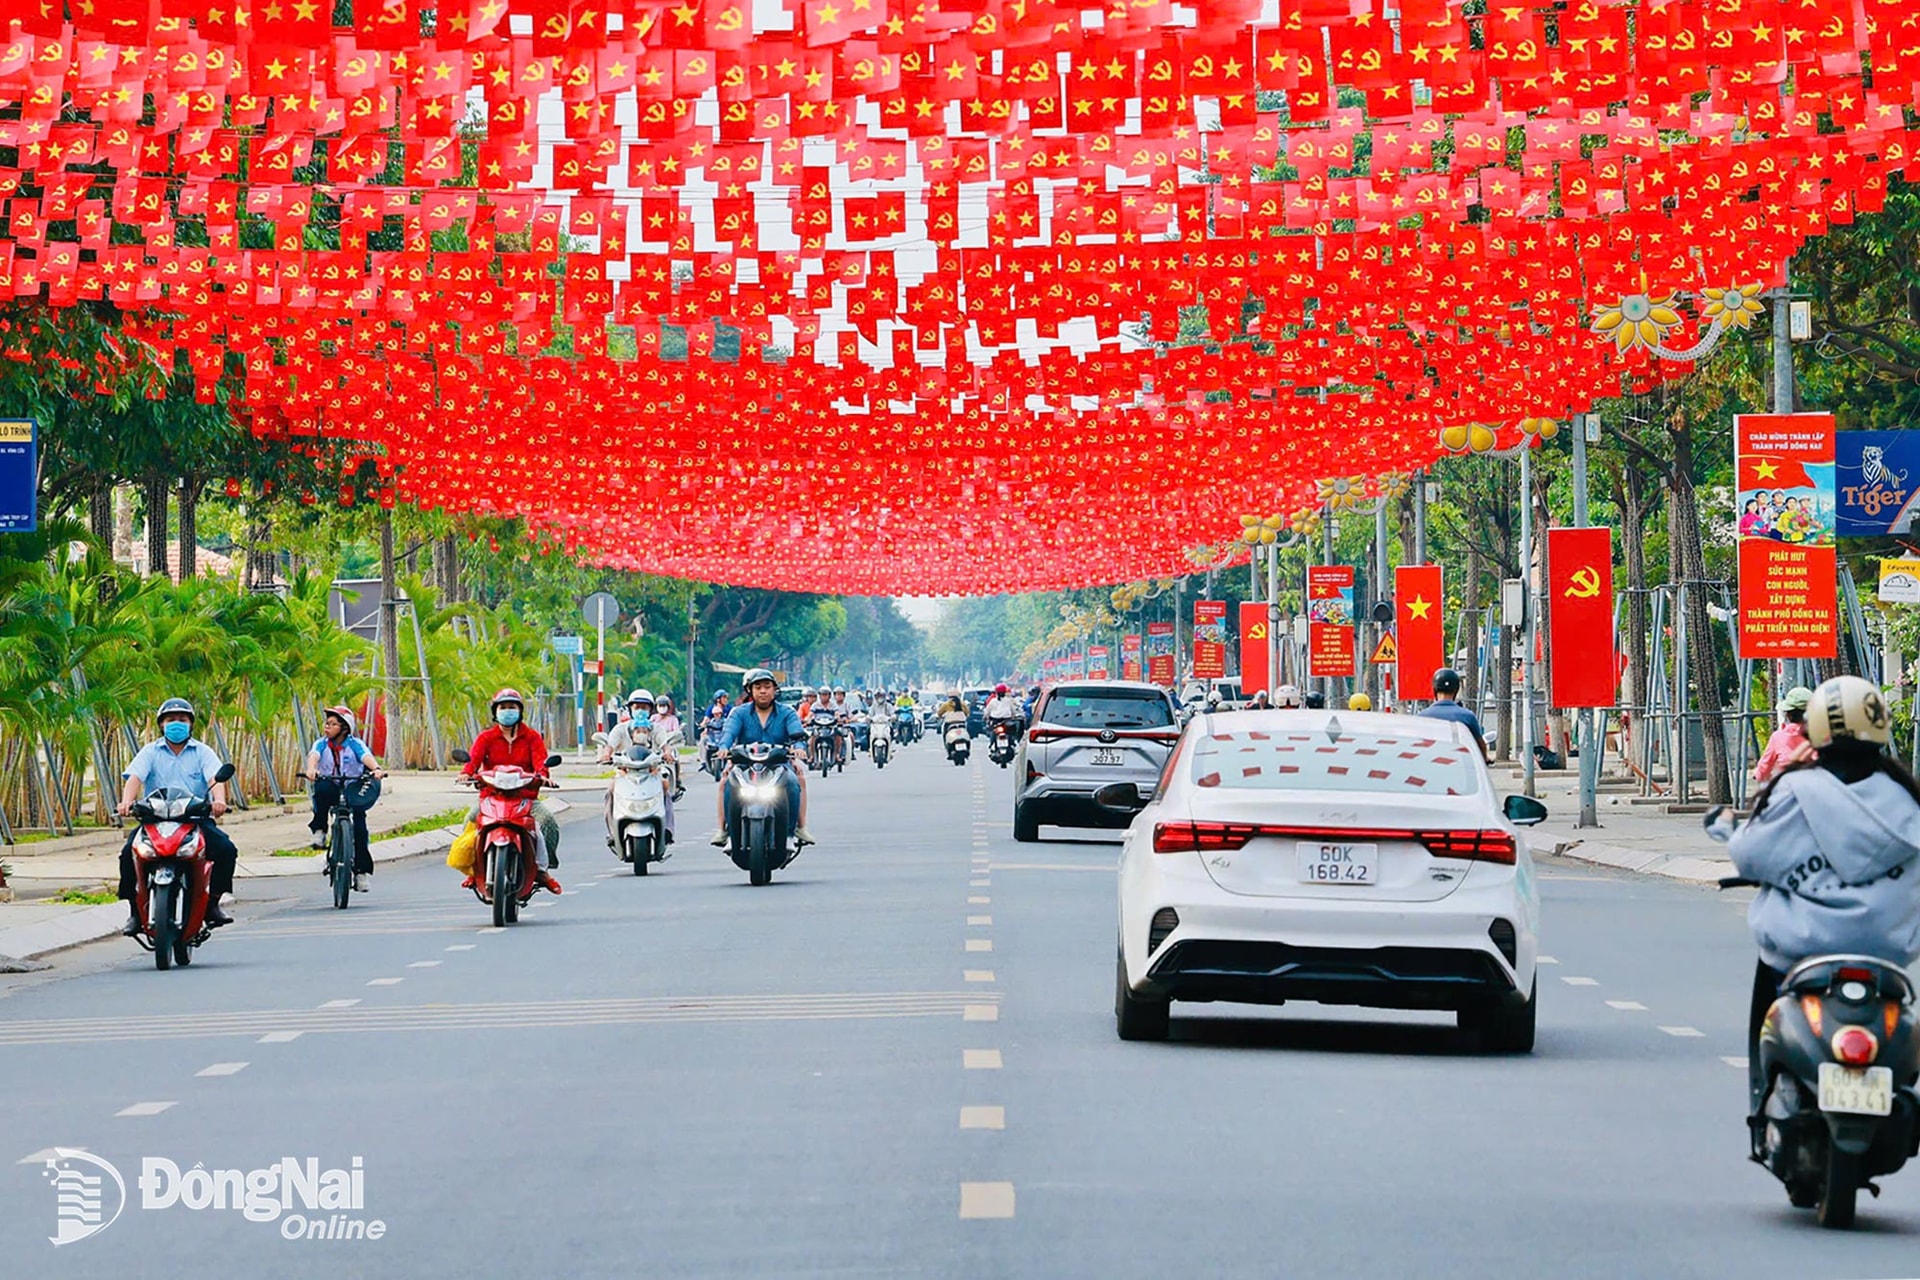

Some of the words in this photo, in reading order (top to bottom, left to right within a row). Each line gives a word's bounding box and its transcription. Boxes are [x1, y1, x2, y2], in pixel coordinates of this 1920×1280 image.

[1789, 432, 1811, 440] THÀNH
[1752, 441, 1773, 450] THÀNH
[1775, 441, 1788, 450] PHỐ
[1841, 484, 1905, 515] Tiger
[1769, 550, 1789, 561] PHÁT
[1790, 551, 1806, 561] HUY
[1768, 565, 1784, 576] SỨC
[1785, 566, 1807, 577] MẠNH
[1766, 581, 1782, 590] CON
[1783, 579, 1810, 590] NGƯỜI,
[1769, 593, 1783, 605] XÂY
[1784, 595, 1806, 606] DỰNG
[1747, 608, 1772, 619] THÀNH
[1774, 608, 1790, 619] PHỐ
[1792, 608, 1813, 619] ĐỒNG
[1815, 609, 1828, 619] NAI
[1745, 622, 1764, 633] PHÁT
[1766, 620, 1787, 633] TRIỂN
[1790, 622, 1809, 633] TOÀN
[1810, 622, 1830, 634] DIỆN!
[1320, 846, 1352, 862] 60K
[1308, 864, 1367, 880] 168.42
